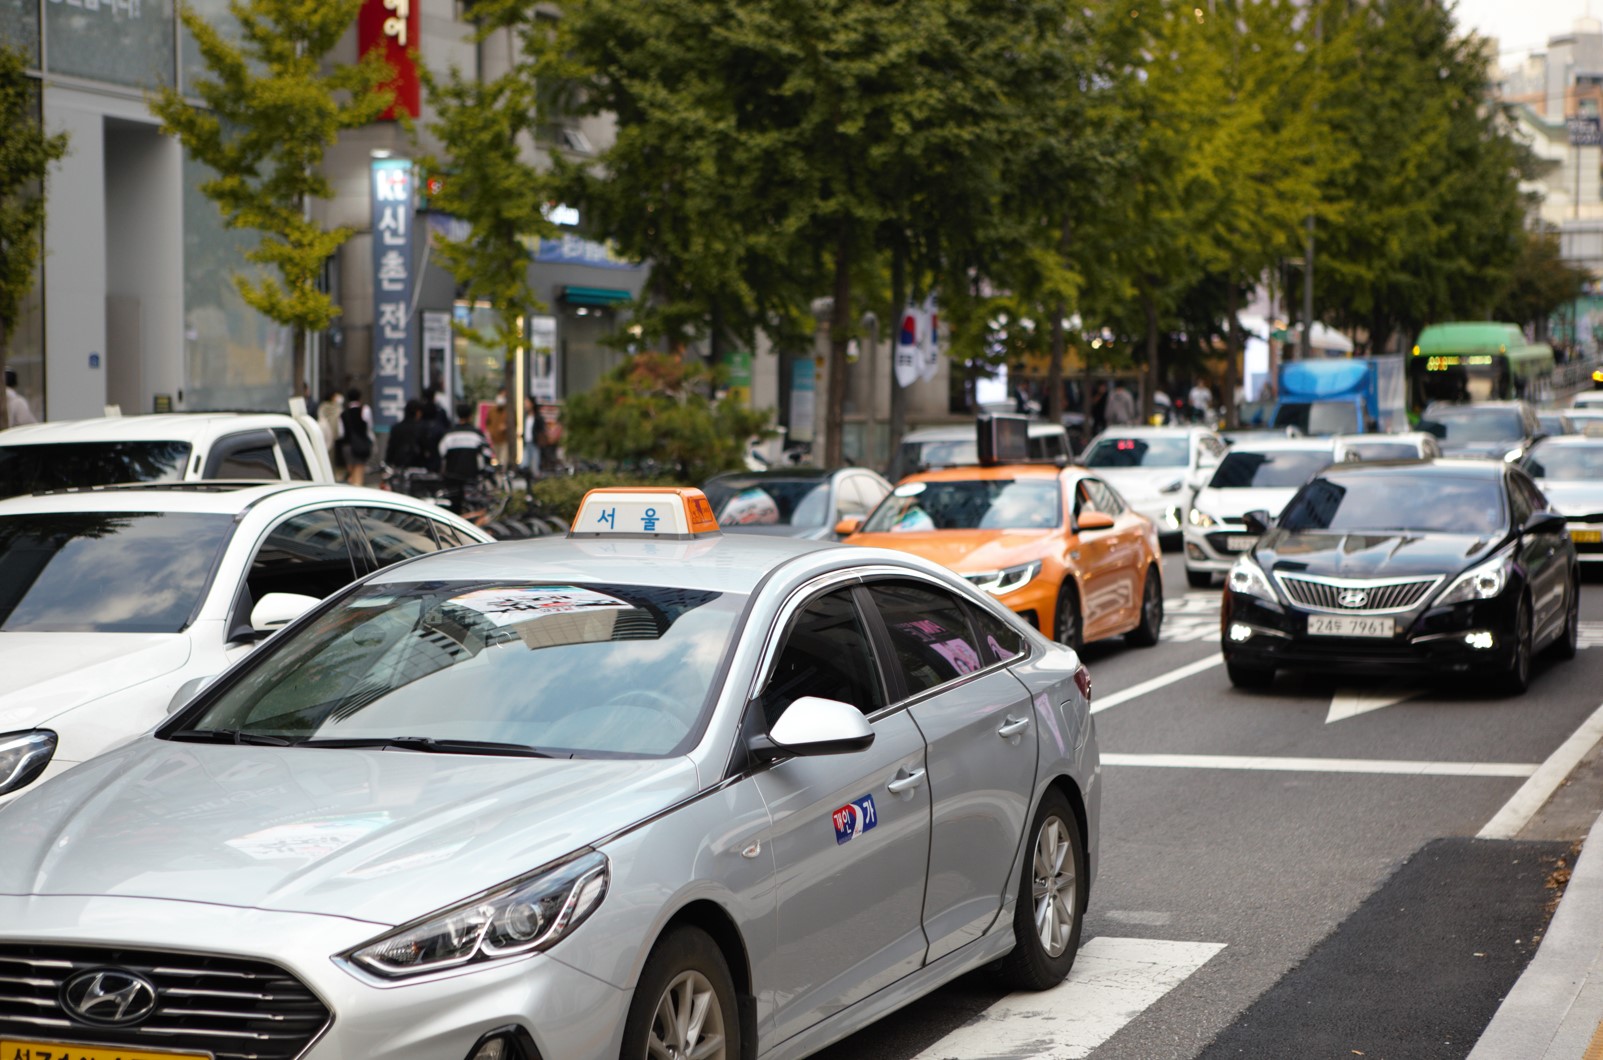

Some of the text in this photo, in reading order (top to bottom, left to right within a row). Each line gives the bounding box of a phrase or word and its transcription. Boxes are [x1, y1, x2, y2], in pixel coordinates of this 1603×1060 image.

[377, 169, 408, 202] kt
[1349, 620, 1384, 635] 7961
[862, 799, 875, 824] 가
